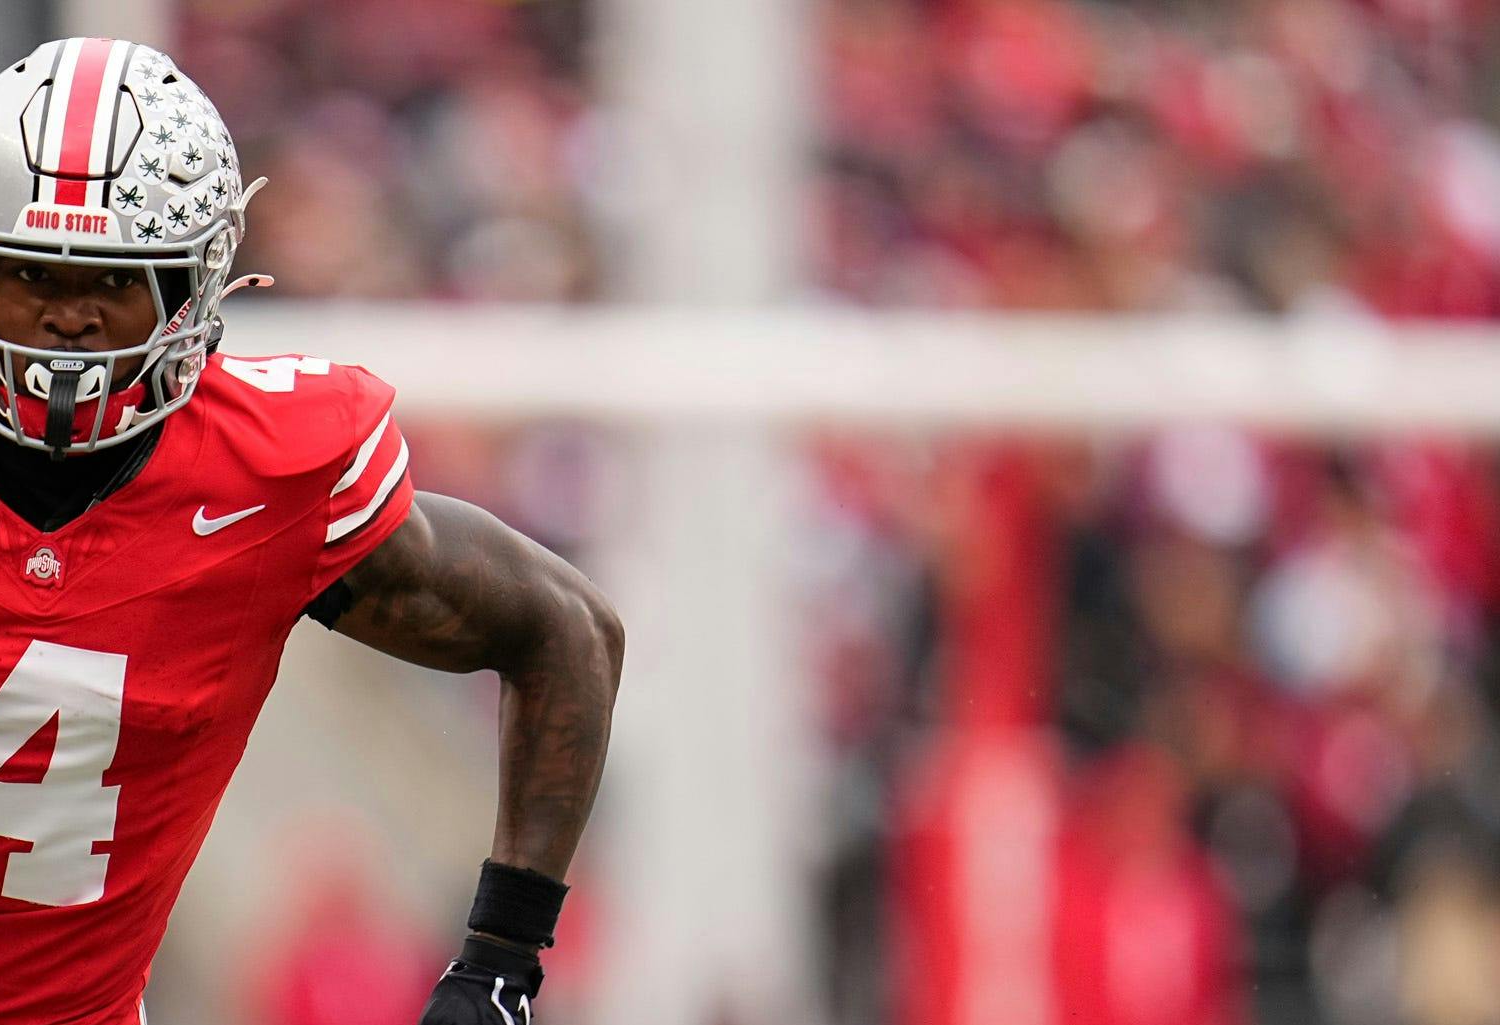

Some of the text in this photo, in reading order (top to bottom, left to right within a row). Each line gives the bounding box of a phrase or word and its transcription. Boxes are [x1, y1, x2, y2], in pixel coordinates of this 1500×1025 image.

[26, 210, 108, 235] OHIO STATE
[220, 356, 331, 393] 4
